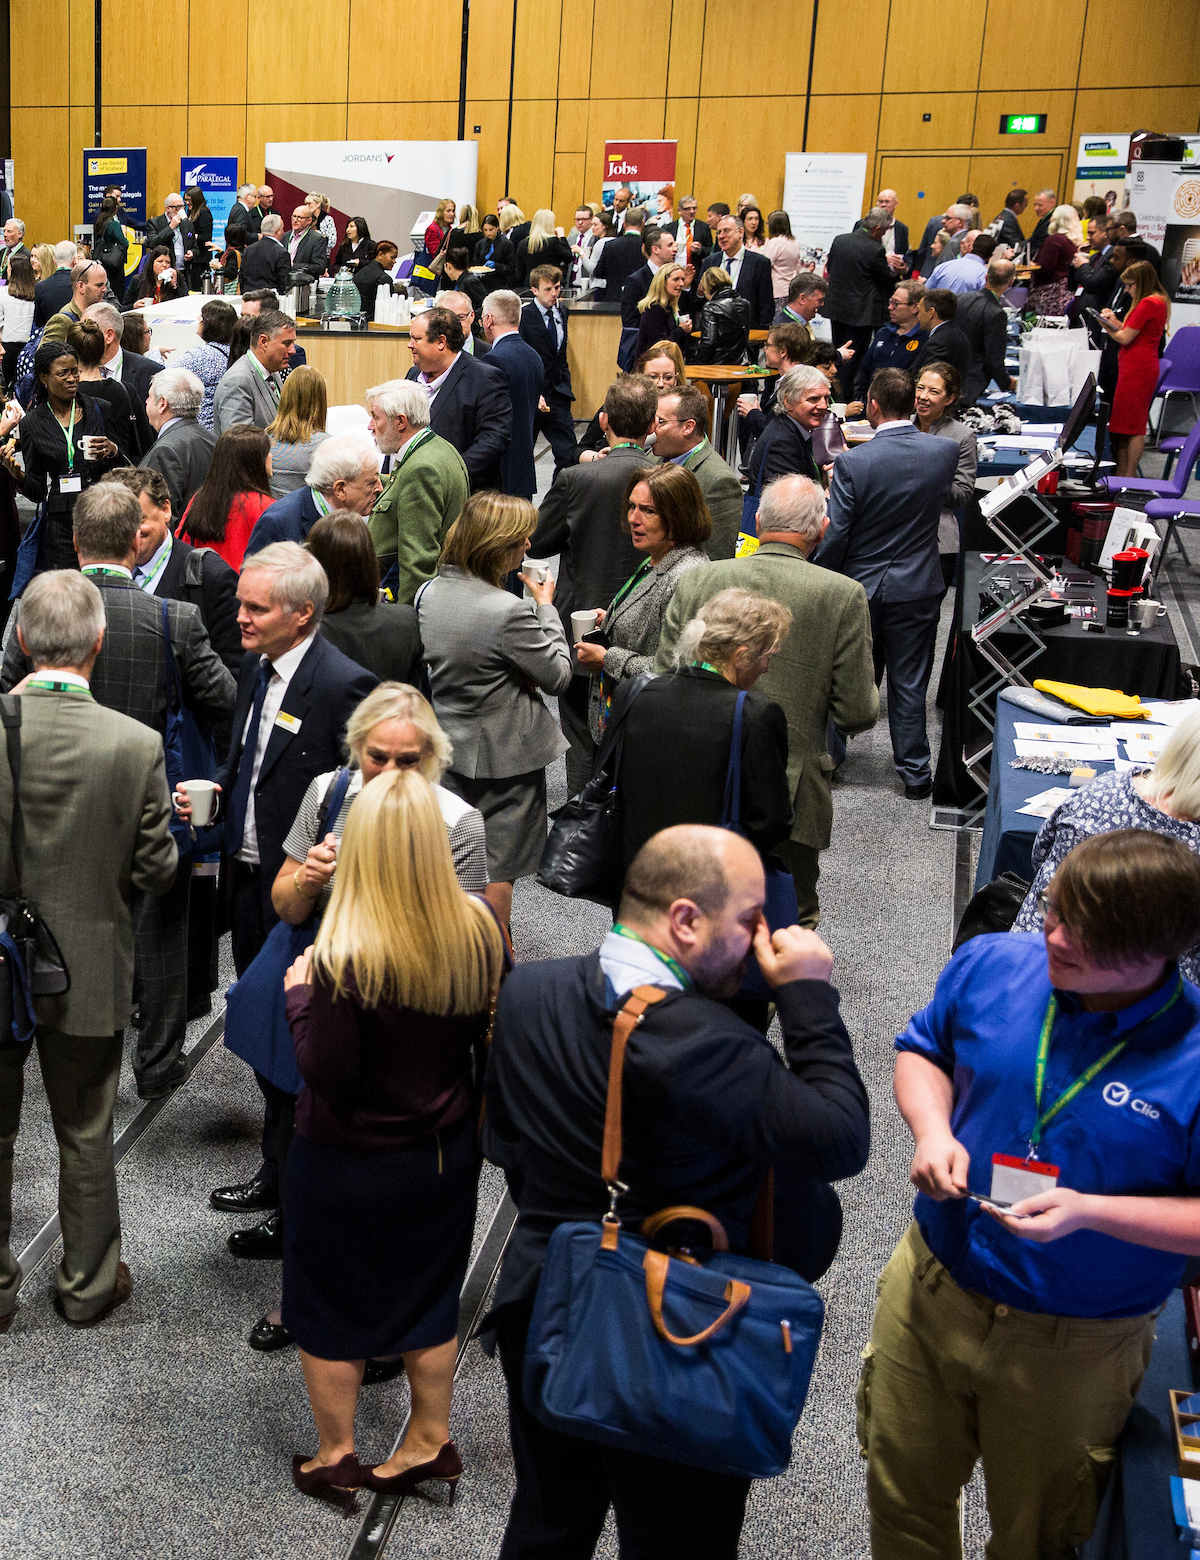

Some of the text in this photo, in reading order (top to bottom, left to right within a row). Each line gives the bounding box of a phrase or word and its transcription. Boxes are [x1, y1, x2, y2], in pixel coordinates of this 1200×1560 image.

[342, 154, 382, 162] JORDANS
[607, 161, 638, 178] Jobs
[1130, 1098, 1160, 1119] Clio
